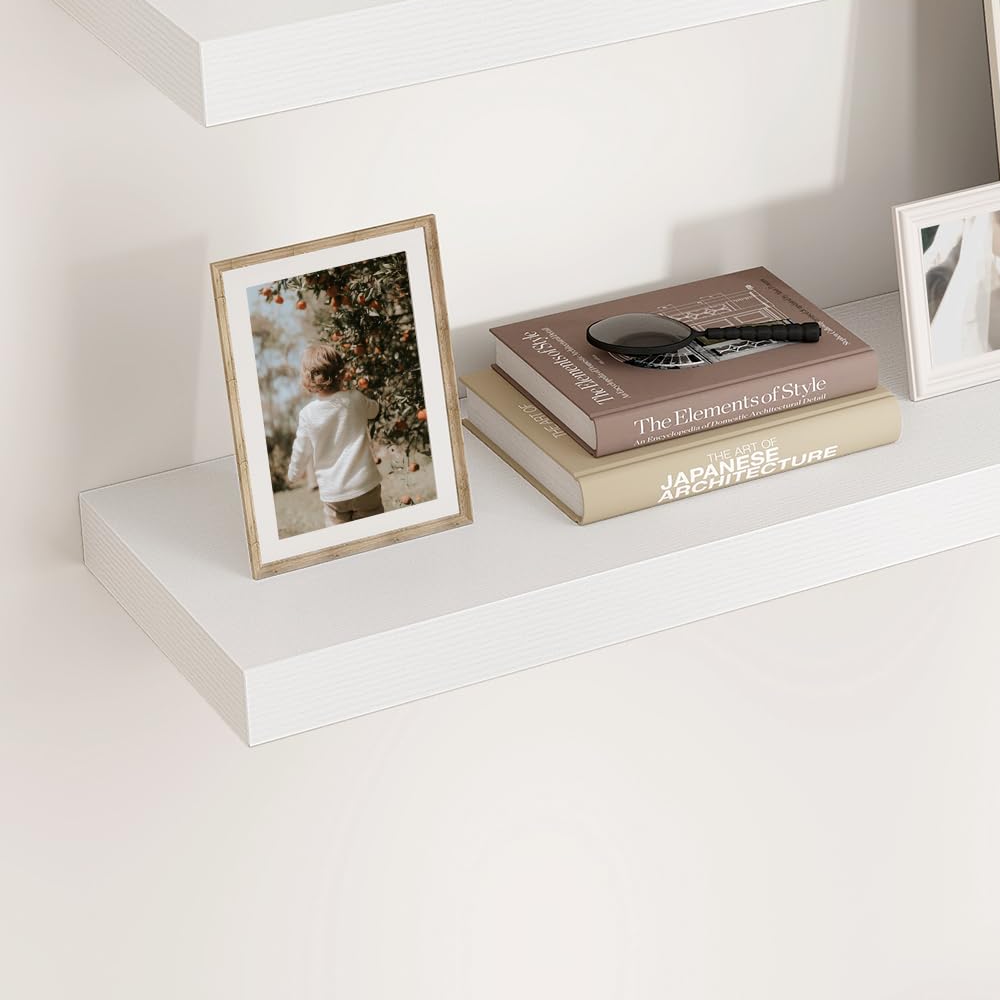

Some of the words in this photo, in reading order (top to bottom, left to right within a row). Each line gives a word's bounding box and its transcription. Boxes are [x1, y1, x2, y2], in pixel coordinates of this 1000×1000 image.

[633, 416, 672, 435] The
[673, 396, 760, 427] Elements
[761, 384, 782, 405] of
[781, 376, 827, 401] Style
[633, 438, 646, 447] An
[706, 448, 731, 464] THE
[734, 442, 758, 458] ART
[761, 437, 777, 450] OF
[657, 445, 839, 503] ARCHITECTURE
[660, 447, 780, 491] JAPANESE
